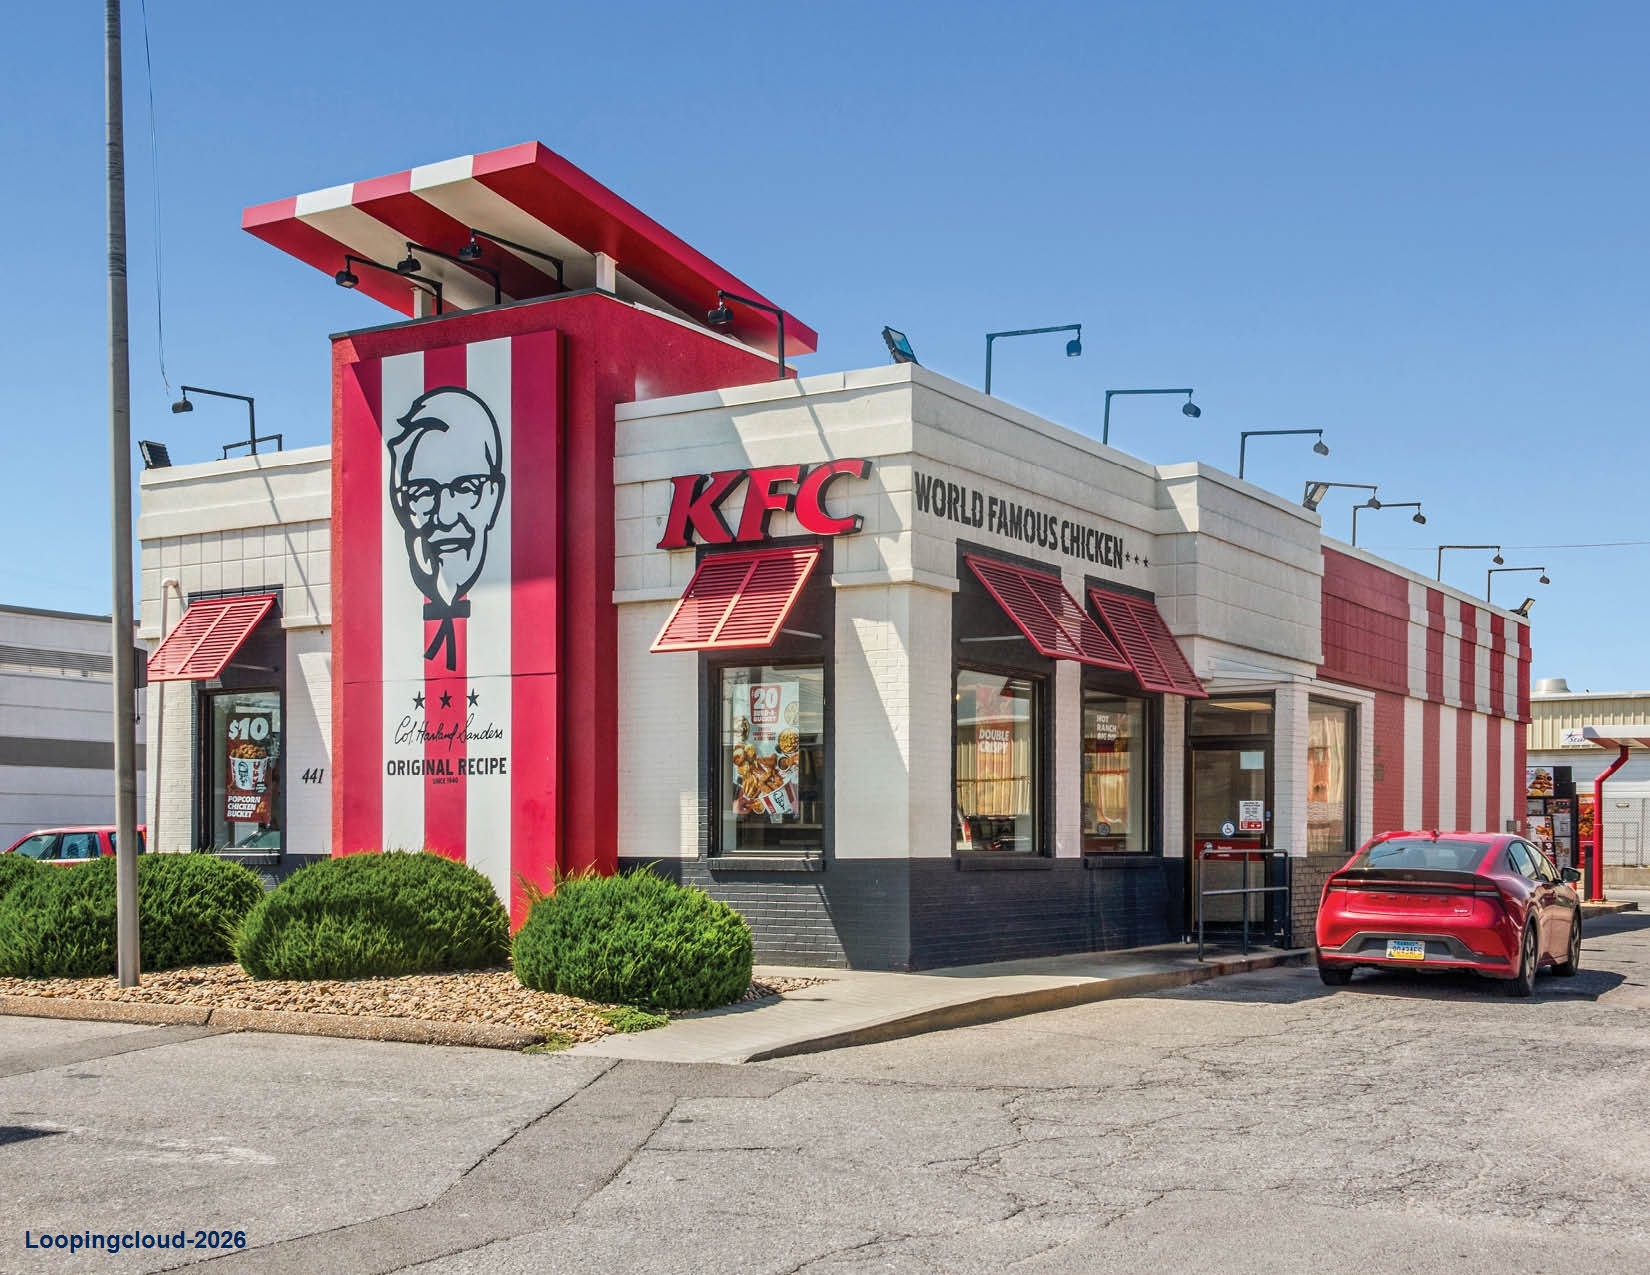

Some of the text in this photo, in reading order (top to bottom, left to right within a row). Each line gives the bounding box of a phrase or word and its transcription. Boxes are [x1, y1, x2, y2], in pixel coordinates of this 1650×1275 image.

[656, 457, 873, 549] KFC
[914, 471, 1123, 570] WORLD FAMOUS CHICKEN
[229, 717, 269, 740] $10
[979, 729, 1010, 741] DOUBLE
[302, 767, 324, 784] 441
[387, 757, 507, 776] ORIGINAL RECIPE
[228, 795, 261, 803] POPCORN
